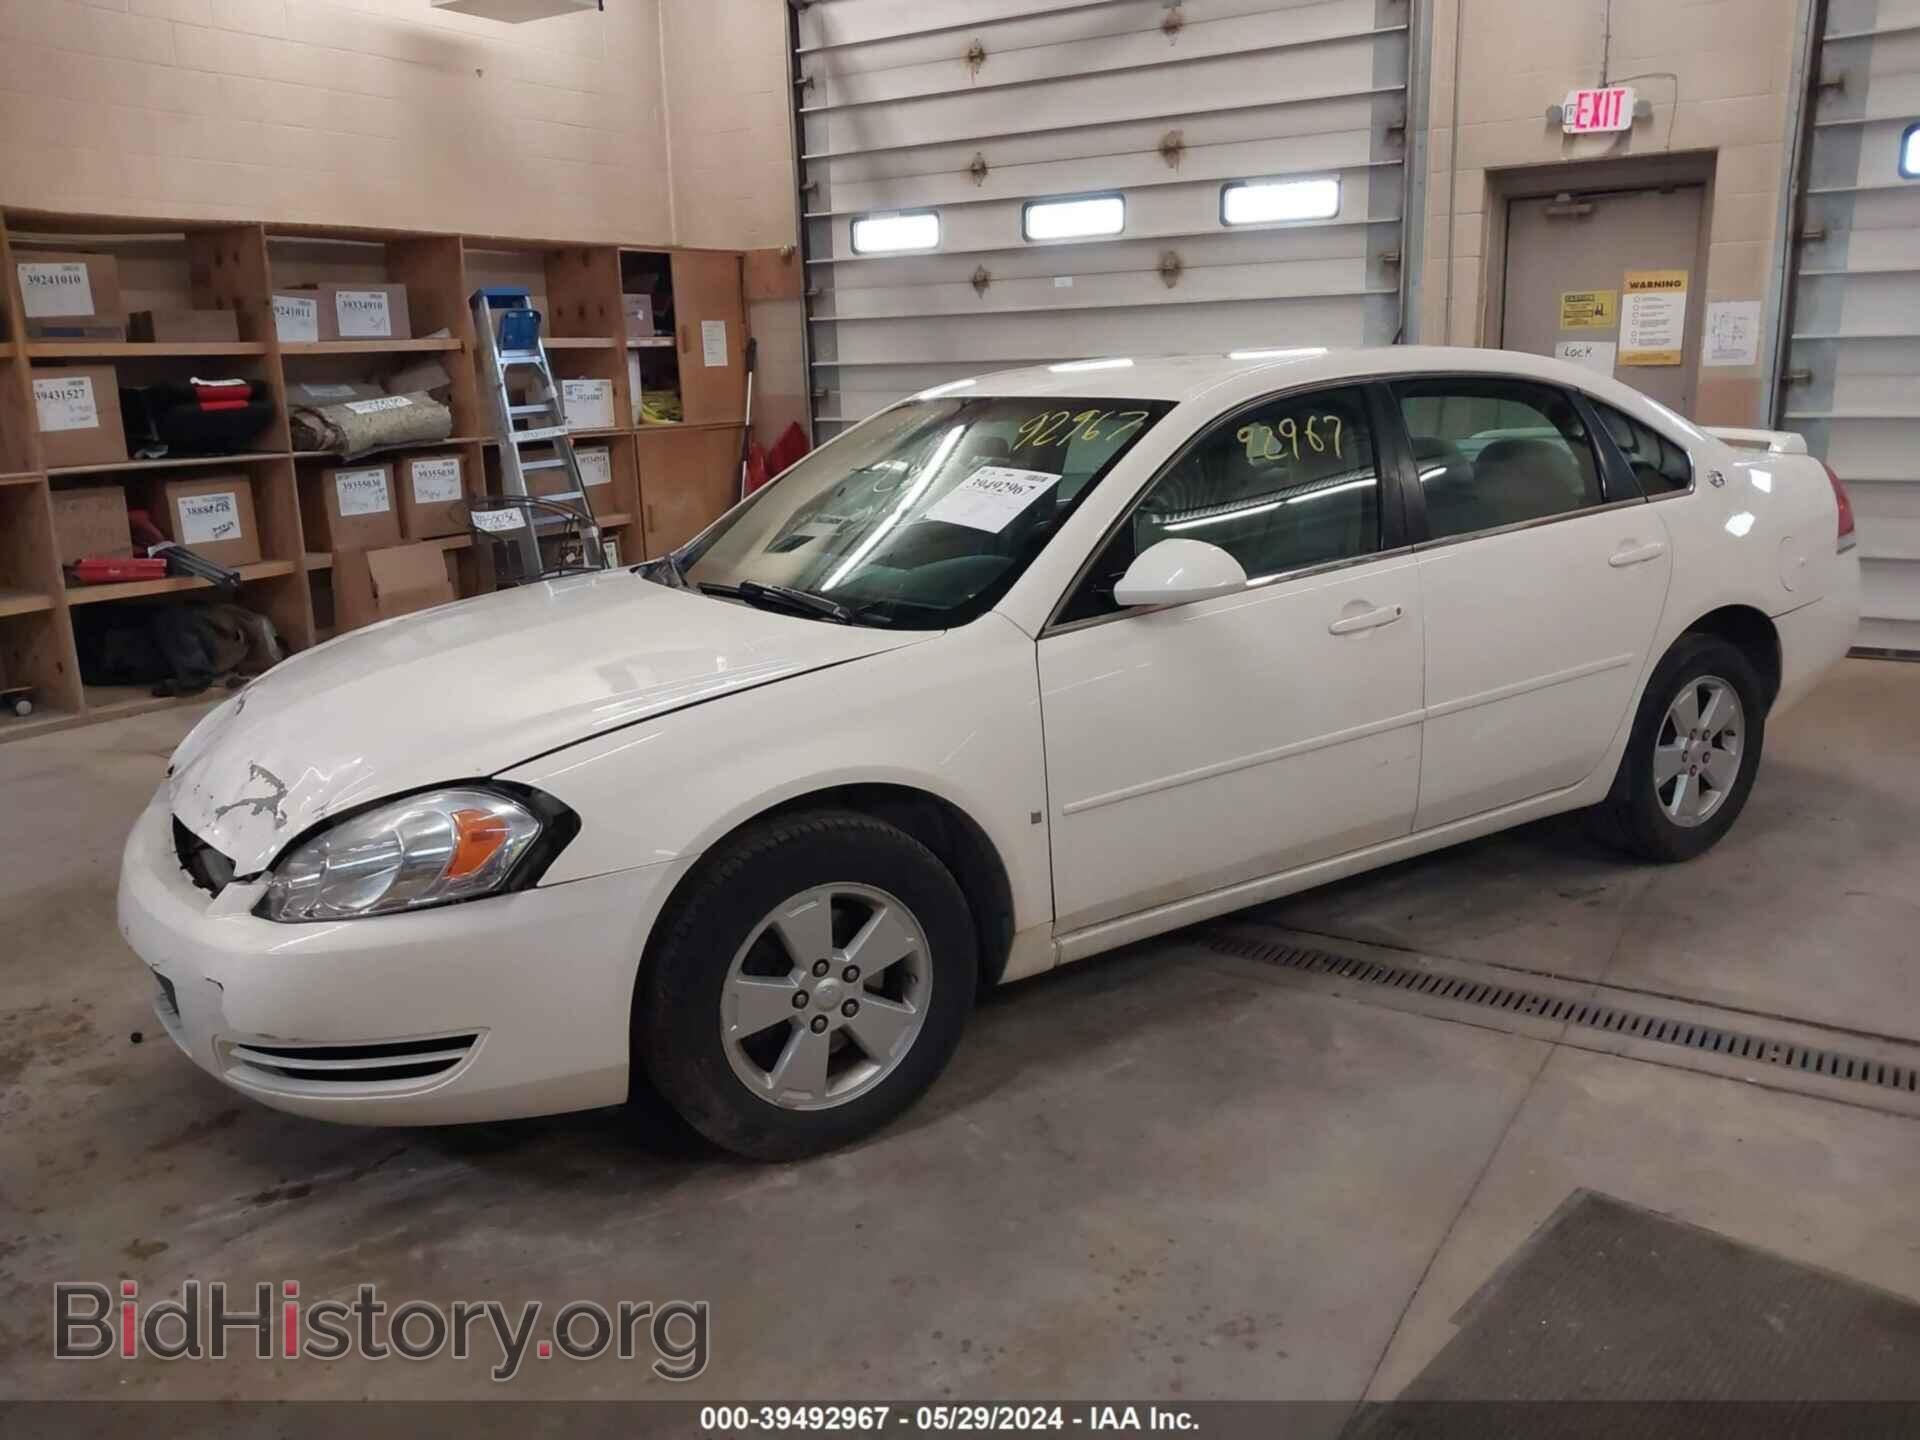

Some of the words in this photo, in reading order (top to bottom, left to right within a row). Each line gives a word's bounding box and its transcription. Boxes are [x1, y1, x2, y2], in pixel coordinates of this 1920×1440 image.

[1575, 90, 1626, 129] EXIT
[26, 273, 81, 286] 39241010
[1629, 280, 1682, 289] WARNING
[273, 304, 311, 319] 9241011
[1012, 409, 1150, 451] 92967
[1236, 415, 1343, 462] 92967
[966, 477, 1036, 496] 39492967
